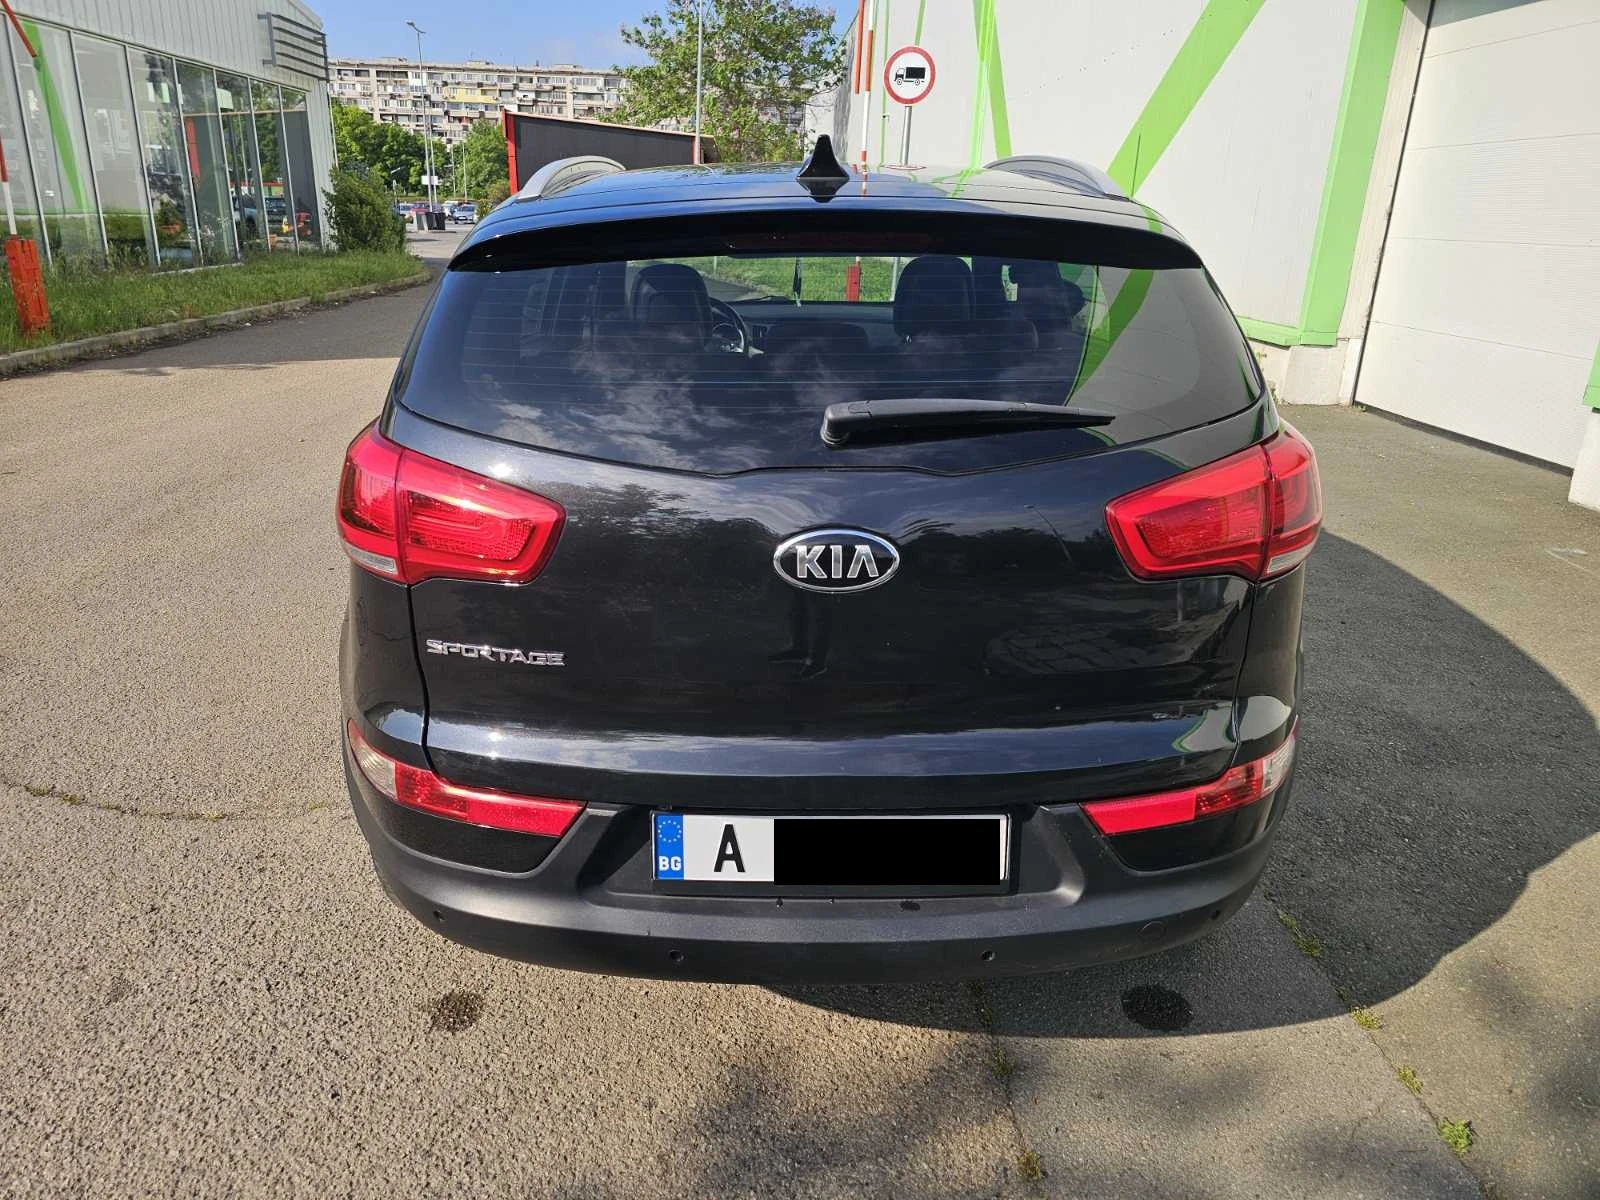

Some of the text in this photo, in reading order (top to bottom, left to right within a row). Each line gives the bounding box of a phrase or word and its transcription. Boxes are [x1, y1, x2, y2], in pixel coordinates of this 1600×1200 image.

[795, 545, 880, 579] KIA
[426, 638, 565, 666] SPORTAGE
[658, 856, 682, 871] BG
